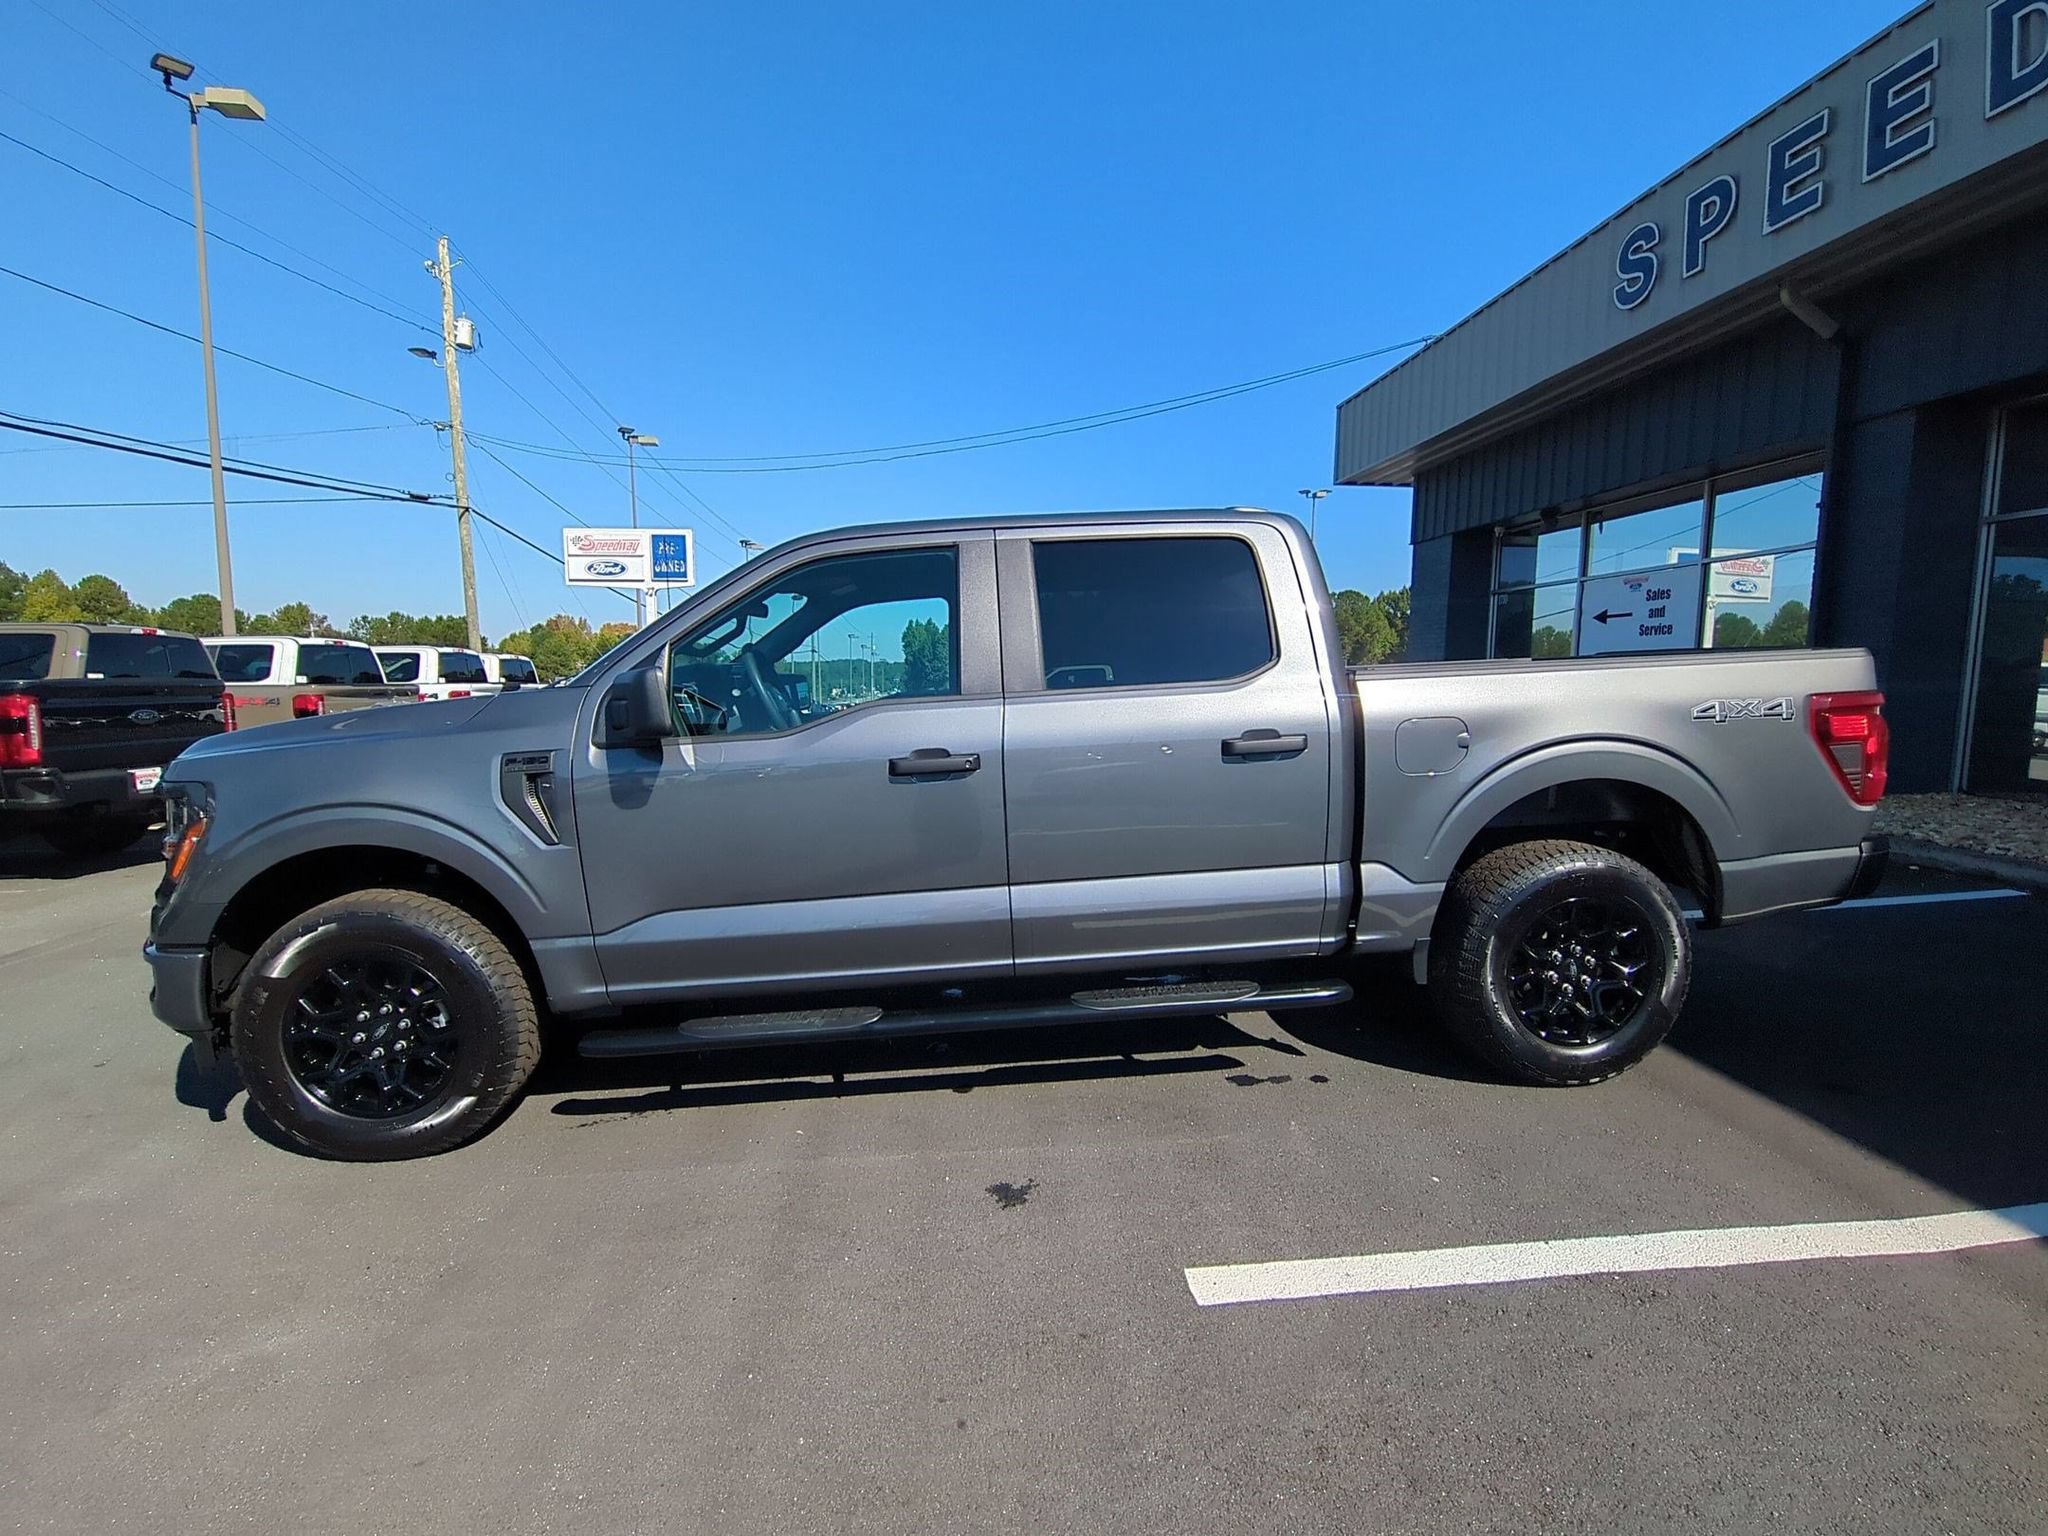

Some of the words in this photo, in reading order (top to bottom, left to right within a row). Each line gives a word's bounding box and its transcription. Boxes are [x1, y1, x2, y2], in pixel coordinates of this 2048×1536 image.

[578, 534, 640, 554] Speedway
[590, 560, 623, 575] Ford
[1645, 587, 1672, 602] Sales
[1648, 605, 1666, 619] and
[1638, 623, 1673, 636] Service
